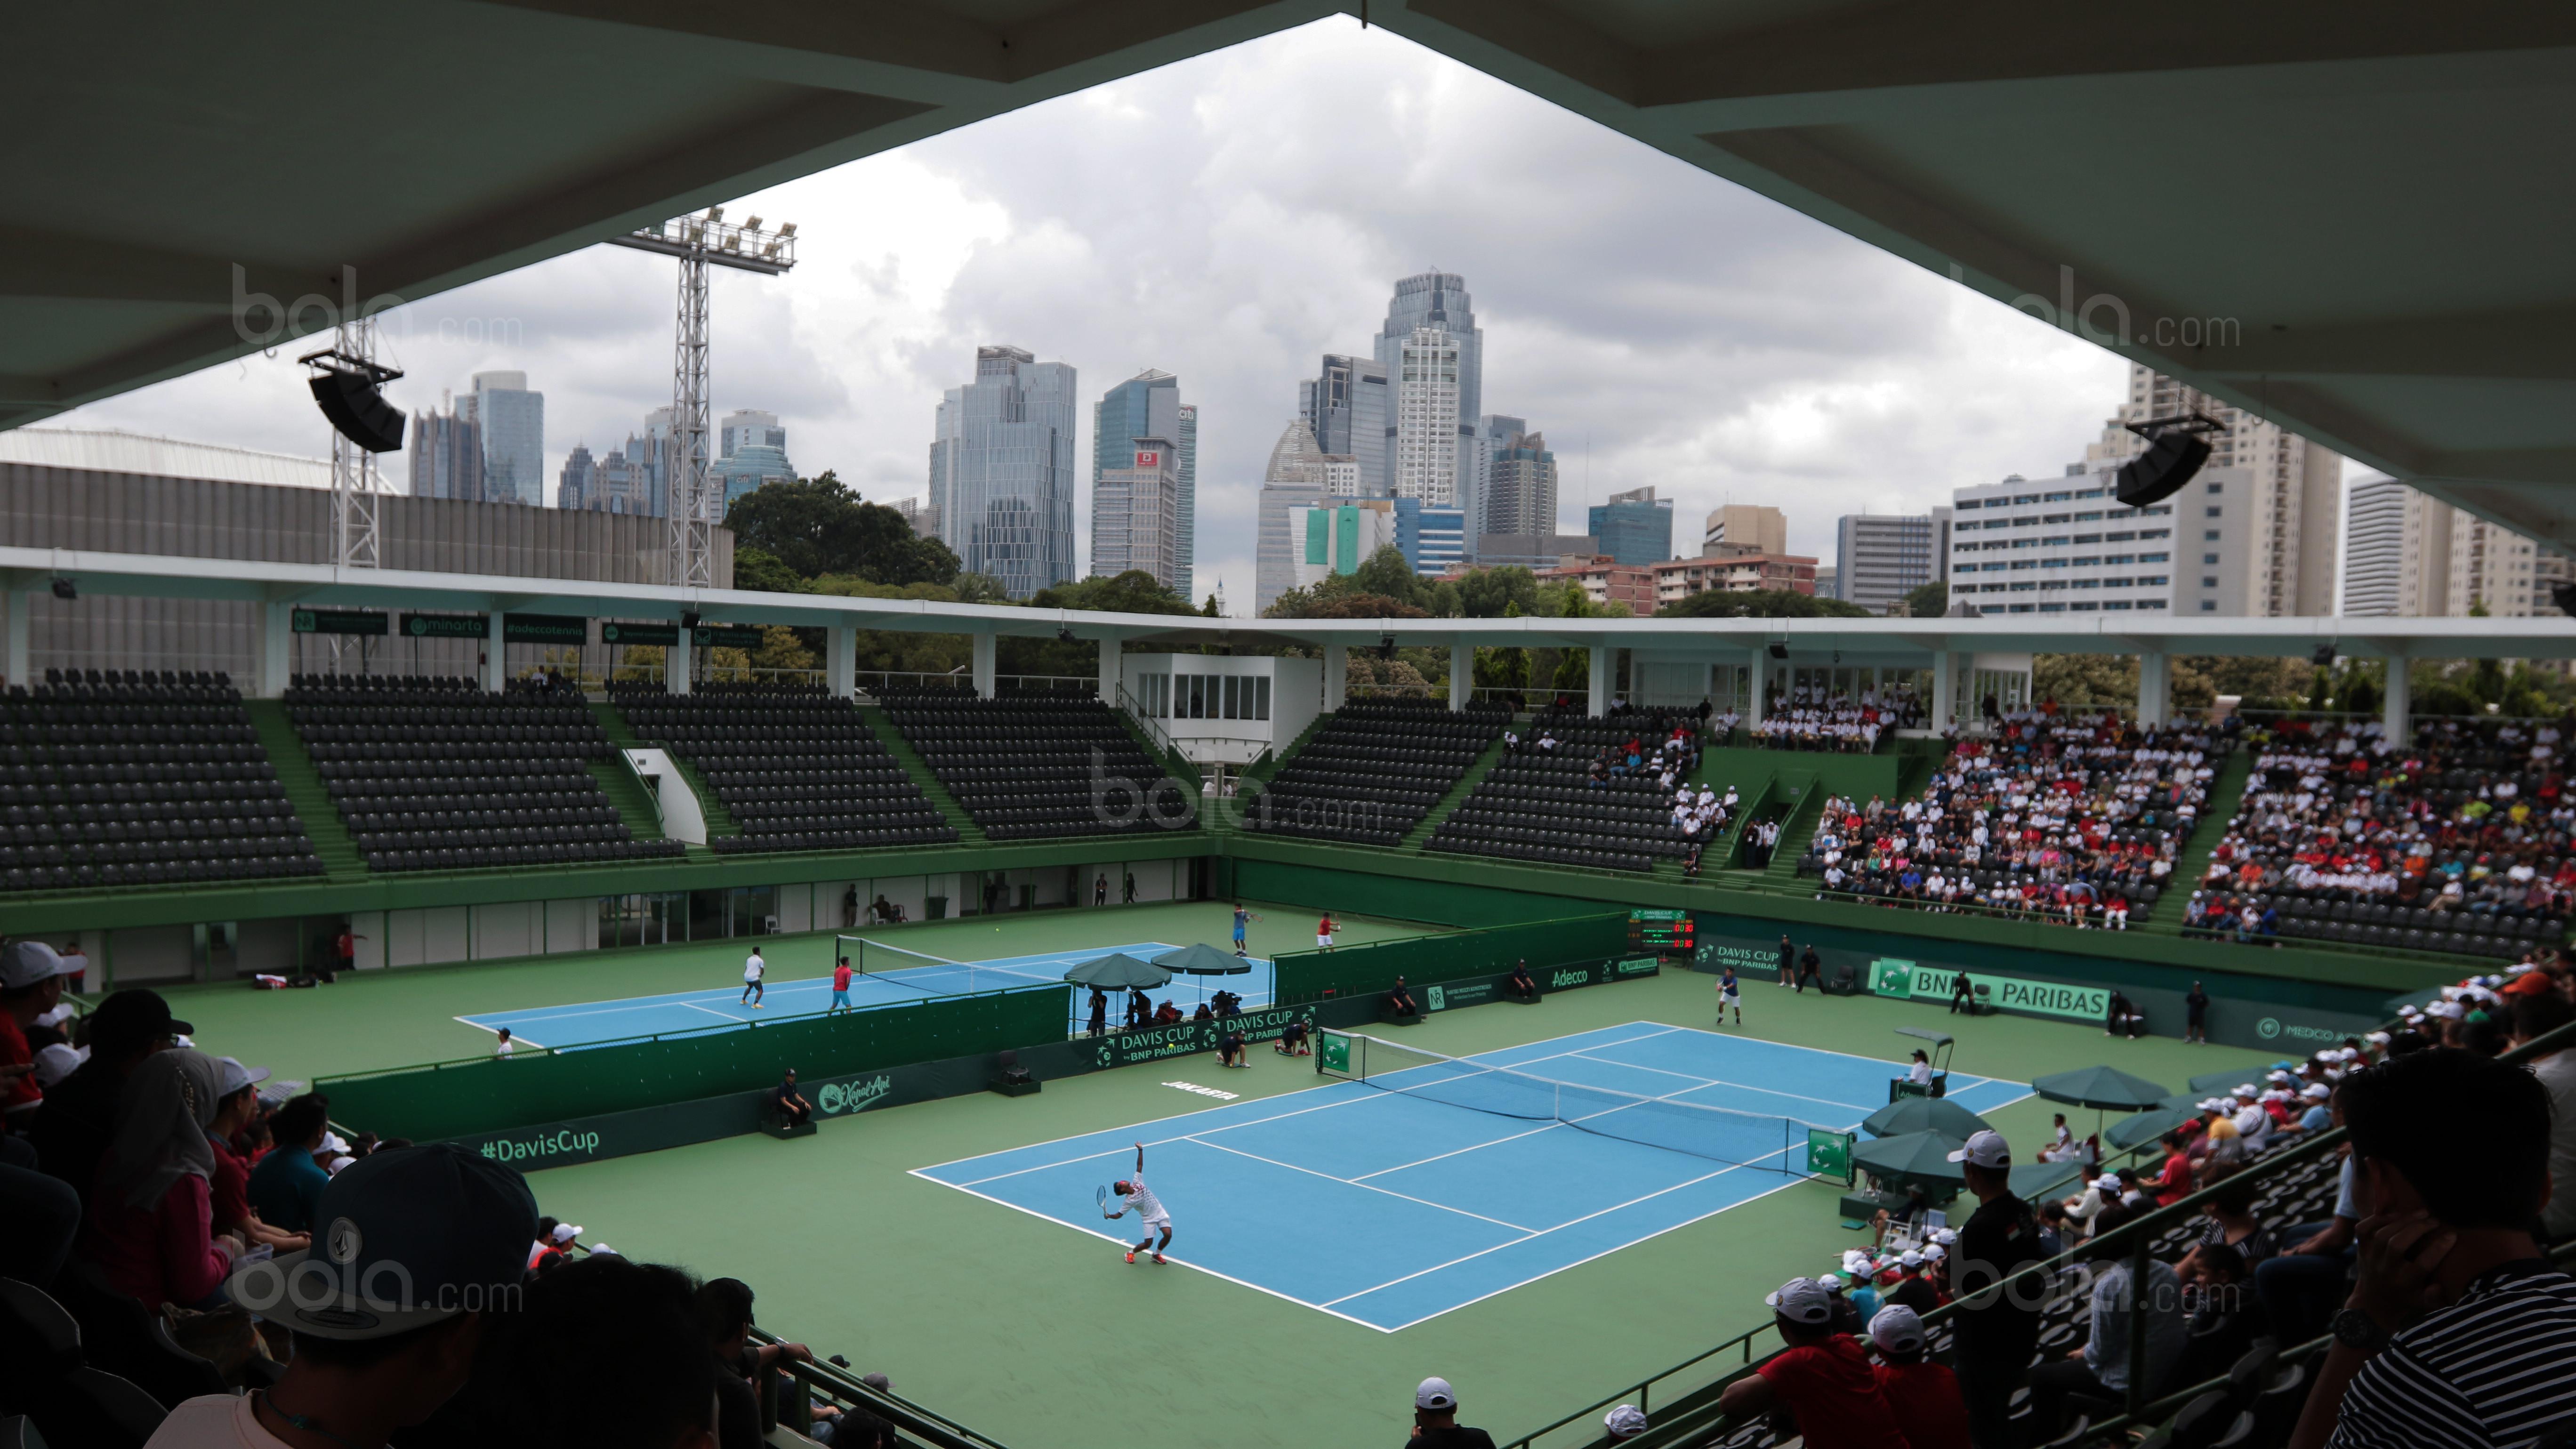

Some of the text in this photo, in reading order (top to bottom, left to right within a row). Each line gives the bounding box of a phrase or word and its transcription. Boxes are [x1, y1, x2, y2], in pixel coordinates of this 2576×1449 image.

[1179, 408, 1194, 419] citi
[427, 618, 483, 631] minarta
[506, 623, 583, 636] #adeccotennis
[1718, 946, 1779, 961] DAVIS CUP
[1741, 960, 1778, 970] PARIBAS
[1552, 969, 1588, 988] Adecco
[2002, 982, 2105, 1014] PARIBAS
[1226, 1011, 1293, 1032] DAVIS CUP
[1122, 1026, 1195, 1050] DAVIS CUP
[1256, 1027, 1288, 1040] PARIB
[2286, 1025, 2334, 1041] MEDCO
[1130, 1050, 1152, 1061] BNP
[1154, 1042, 1196, 1057] PARIBAS
[1161, 1081, 1240, 1100] JAKARTA
[480, 1130, 599, 1161] #DavisCup
